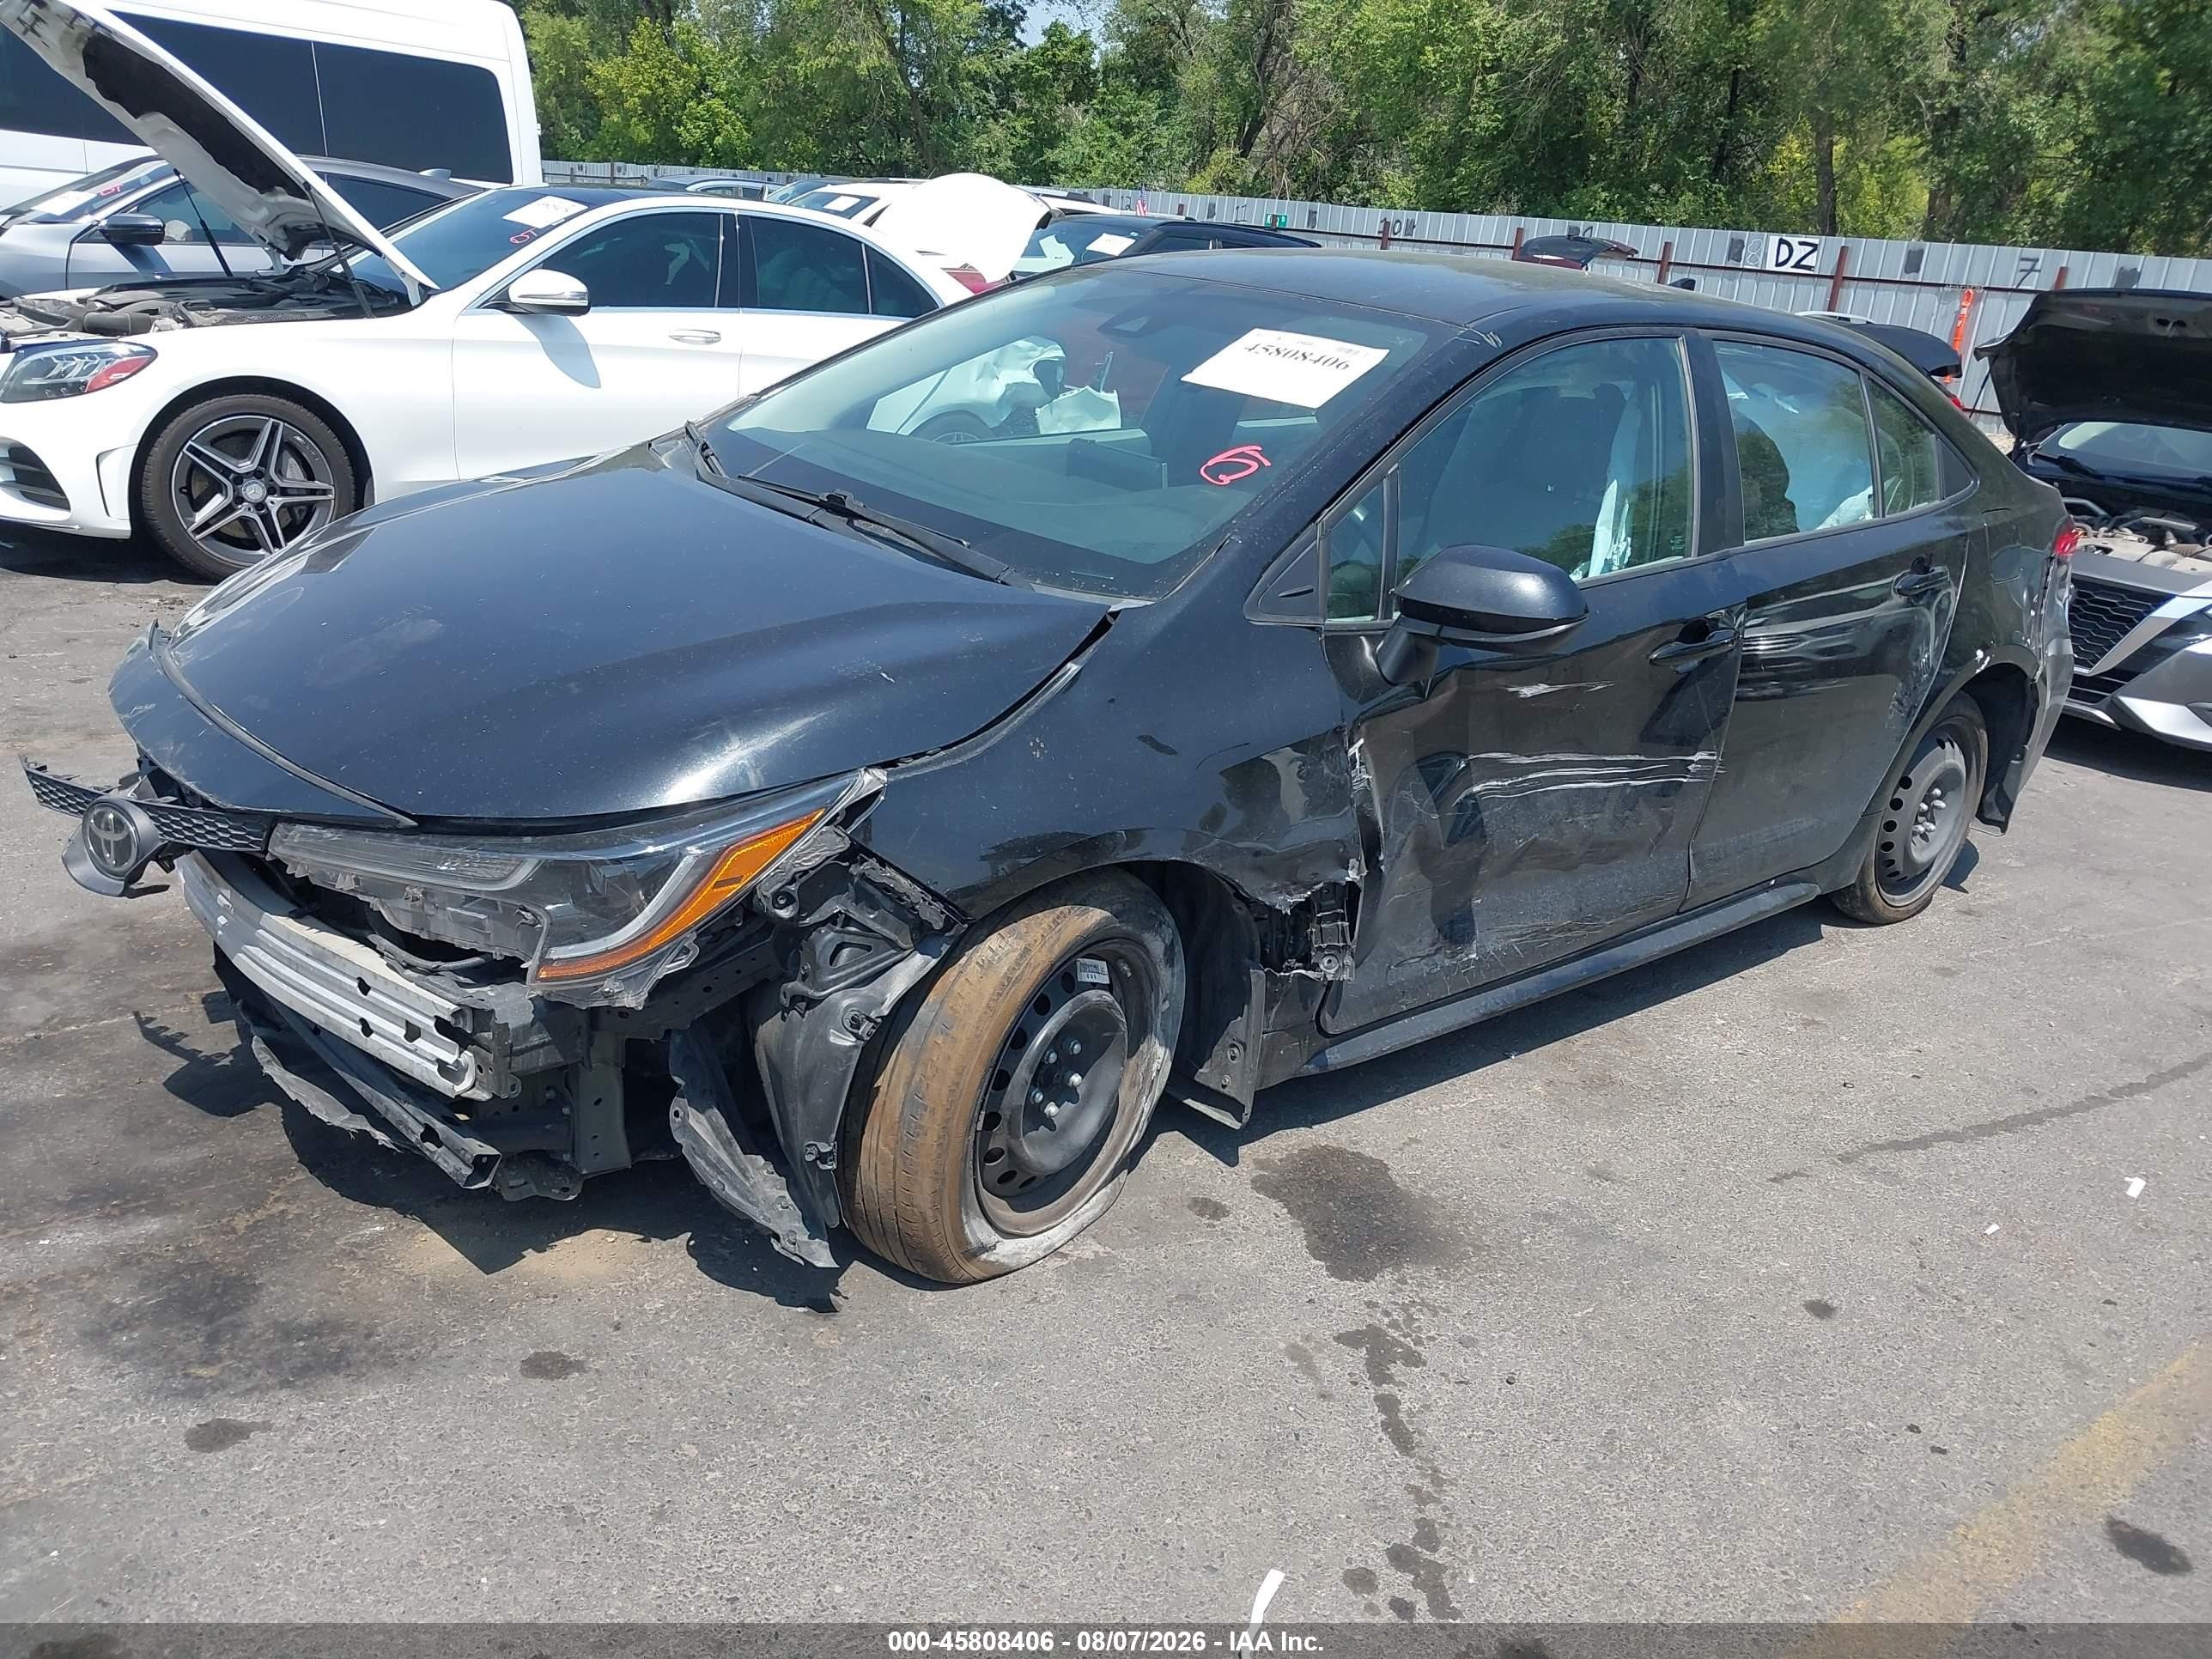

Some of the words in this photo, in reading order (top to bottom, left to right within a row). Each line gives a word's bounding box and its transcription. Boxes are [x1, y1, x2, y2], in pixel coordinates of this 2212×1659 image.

[1775, 238, 1819, 271] DZ
[2016, 257, 2041, 289] 7
[1244, 343, 1350, 371] 45808406
